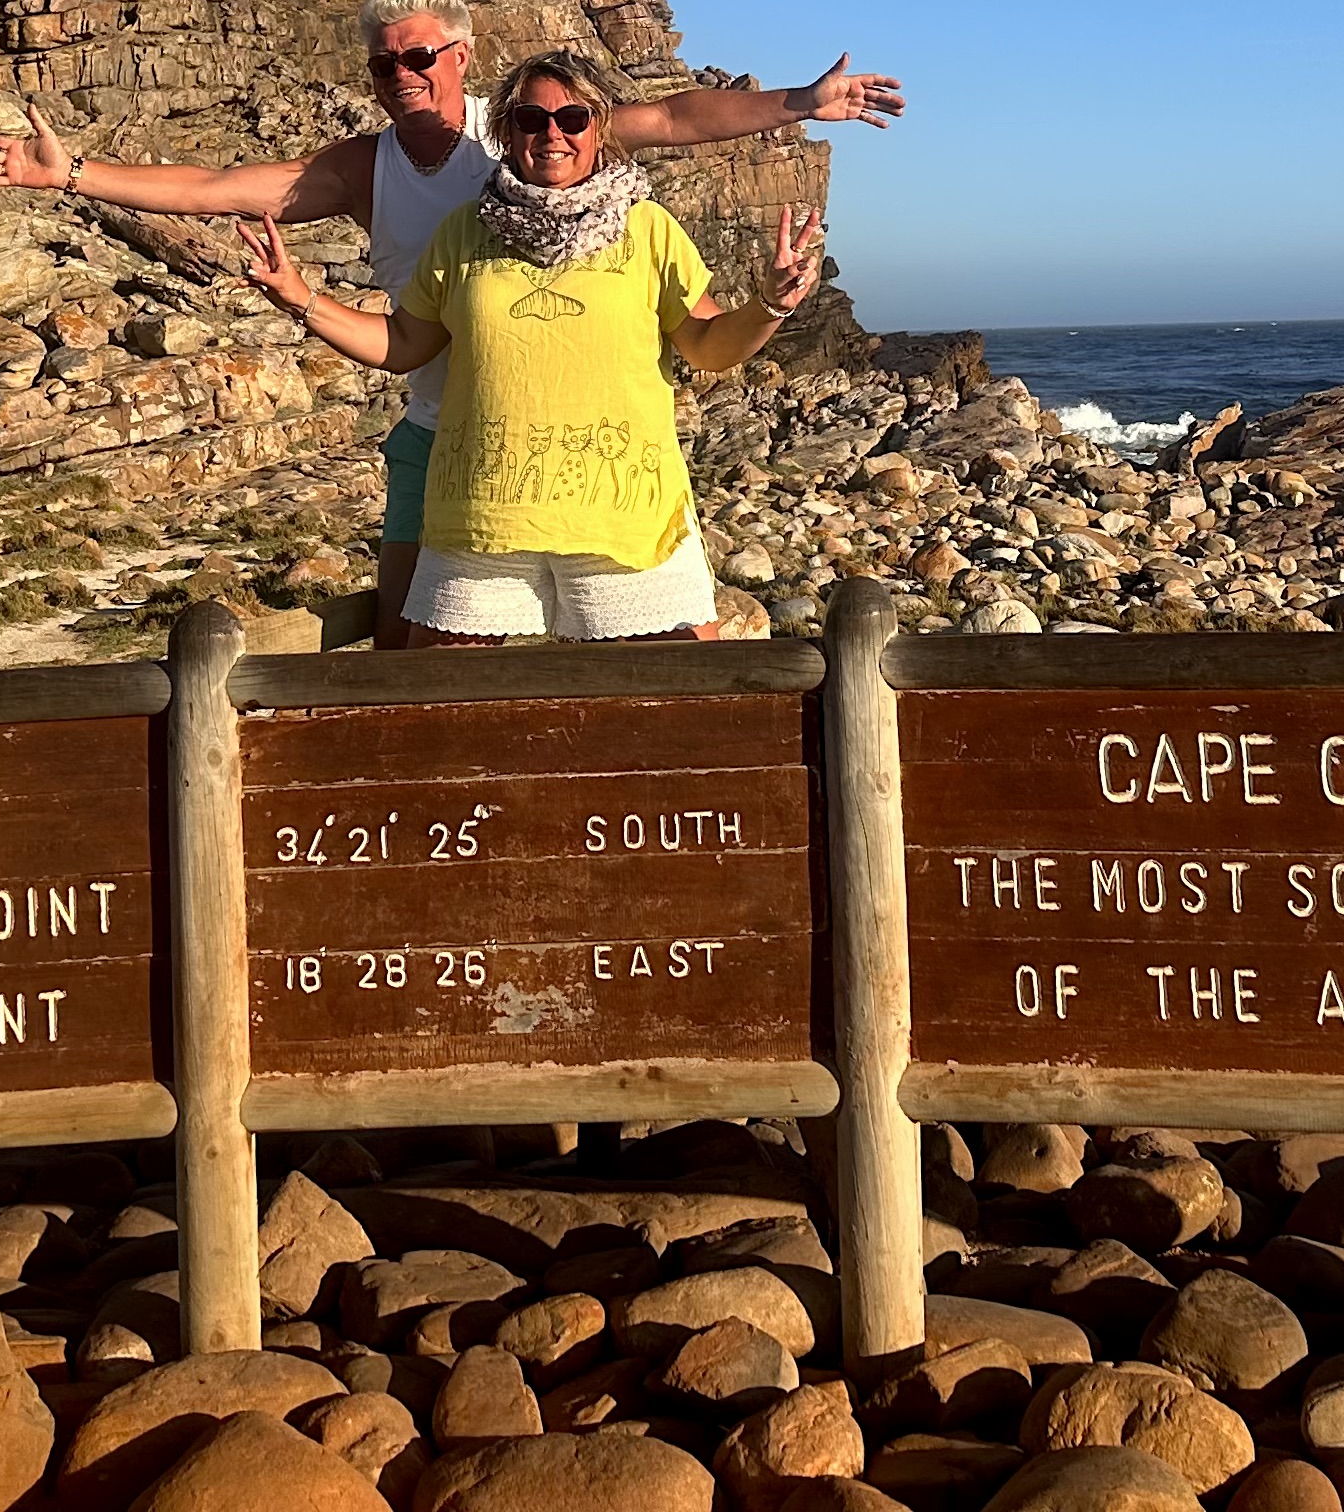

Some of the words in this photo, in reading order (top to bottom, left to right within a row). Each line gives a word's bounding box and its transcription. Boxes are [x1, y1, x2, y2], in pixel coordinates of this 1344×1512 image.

[1096, 734, 1280, 804] CAPE
[585, 810, 743, 851] SOUTH
[953, 856, 1061, 910] THE
[1091, 859, 1251, 912] MOST
[593, 941, 725, 979] EAST
[1014, 962, 1081, 1018] OF
[1146, 965, 1261, 1022] THE
